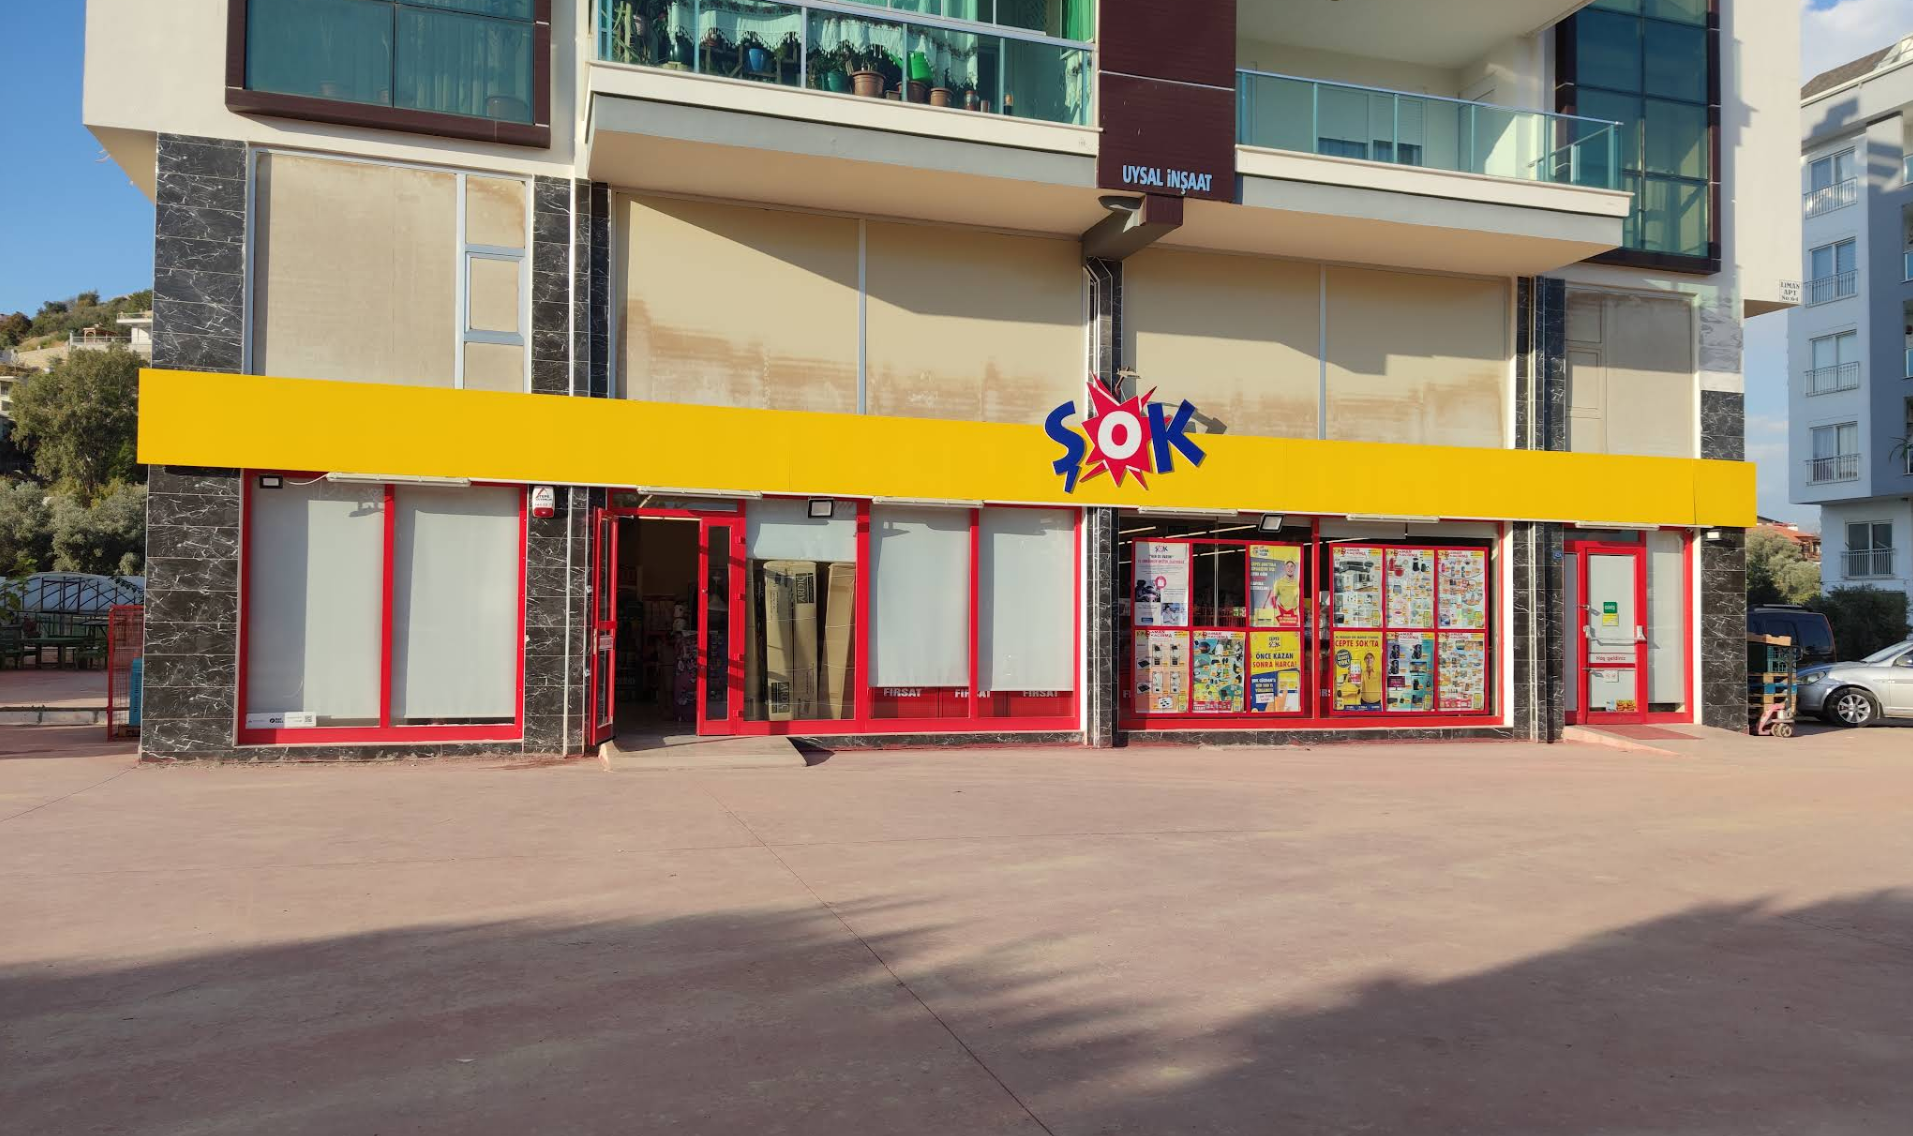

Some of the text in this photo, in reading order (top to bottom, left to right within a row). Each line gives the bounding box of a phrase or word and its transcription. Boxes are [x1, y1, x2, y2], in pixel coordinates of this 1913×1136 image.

[1122, 165, 1163, 186] UYSAL
[1045, 398, 1207, 494] ŞOK
[1255, 651, 1294, 660] ÖNCE KAZAN
[884, 688, 921, 697] FIRSAT
